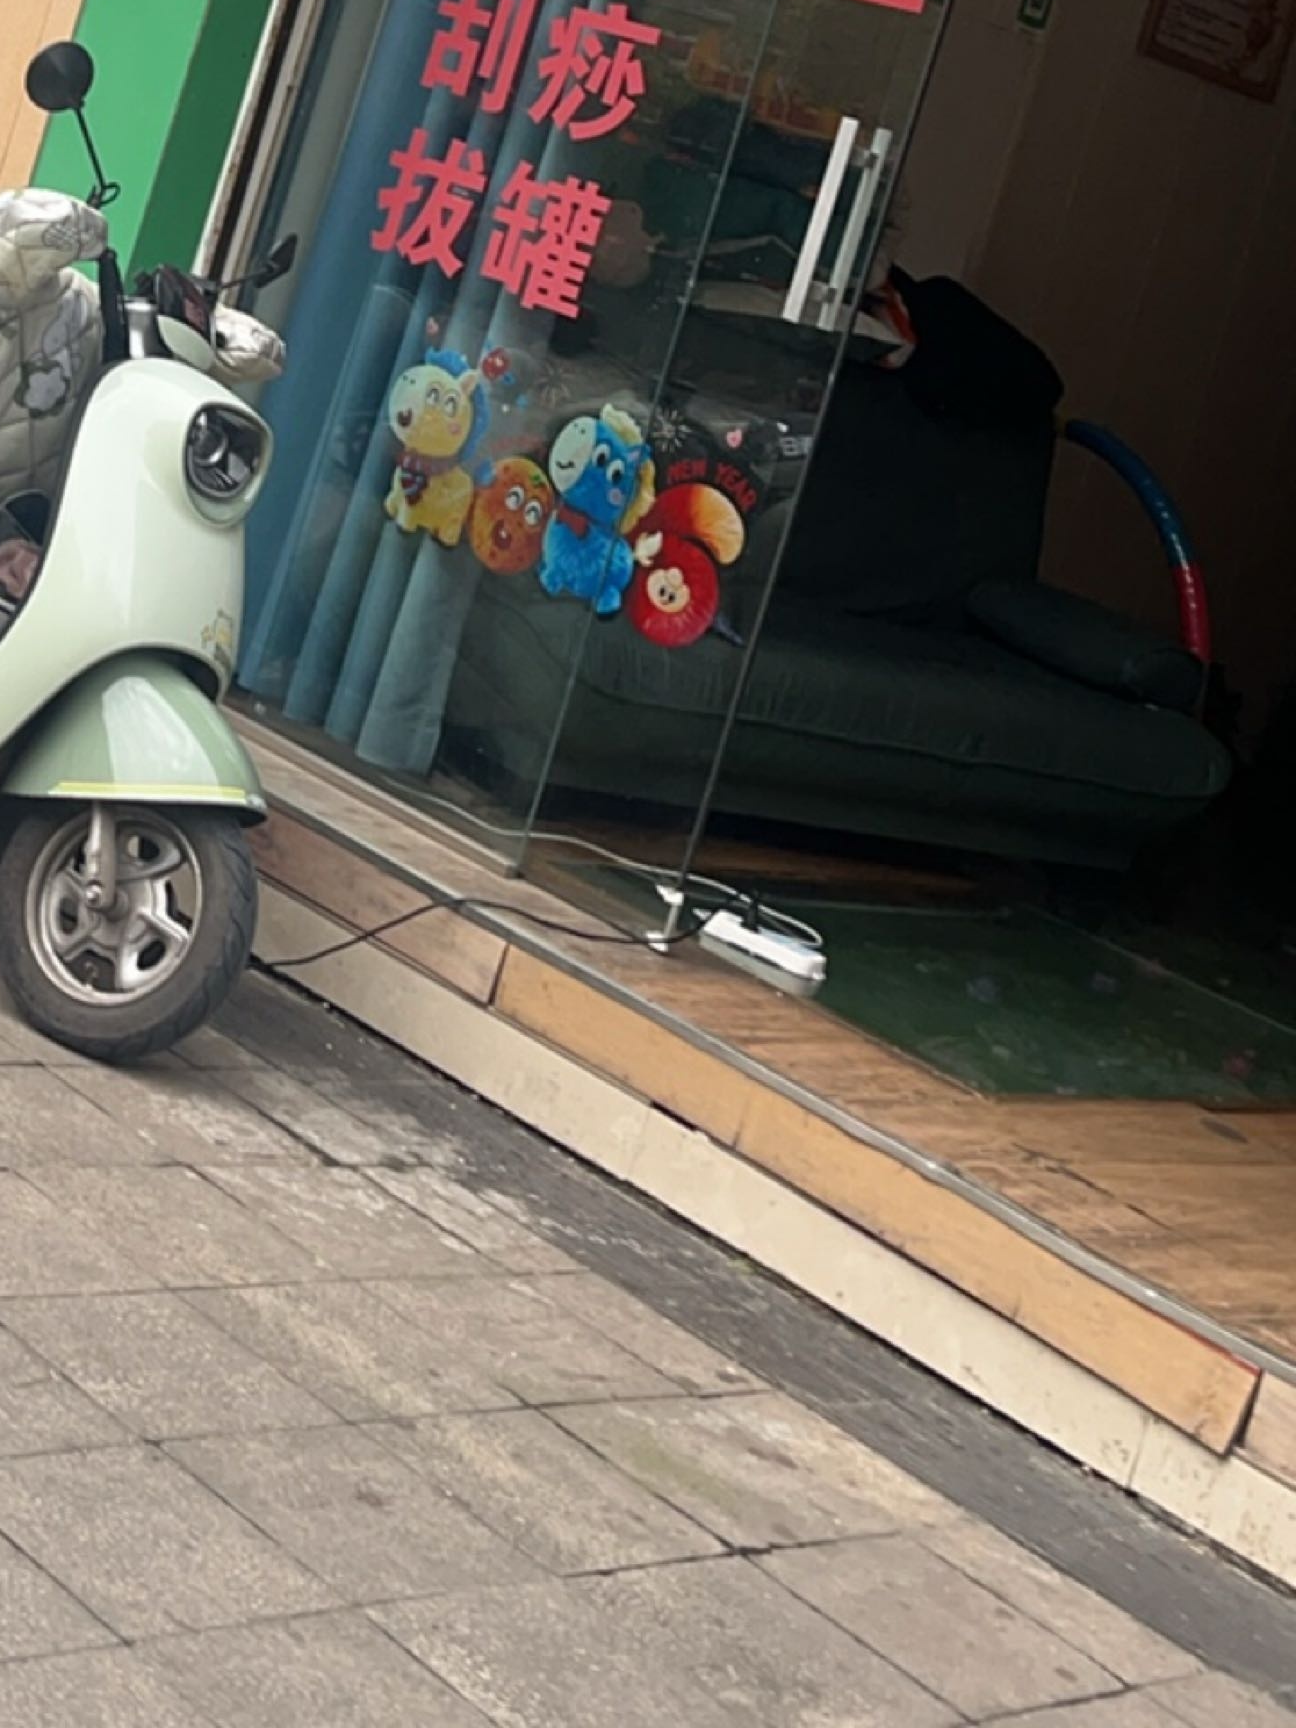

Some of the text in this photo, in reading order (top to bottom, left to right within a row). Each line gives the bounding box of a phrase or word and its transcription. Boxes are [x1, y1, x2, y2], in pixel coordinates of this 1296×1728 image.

[370, 129, 612, 321] 拔罐
[667, 458, 757, 512] NEW YEAR
